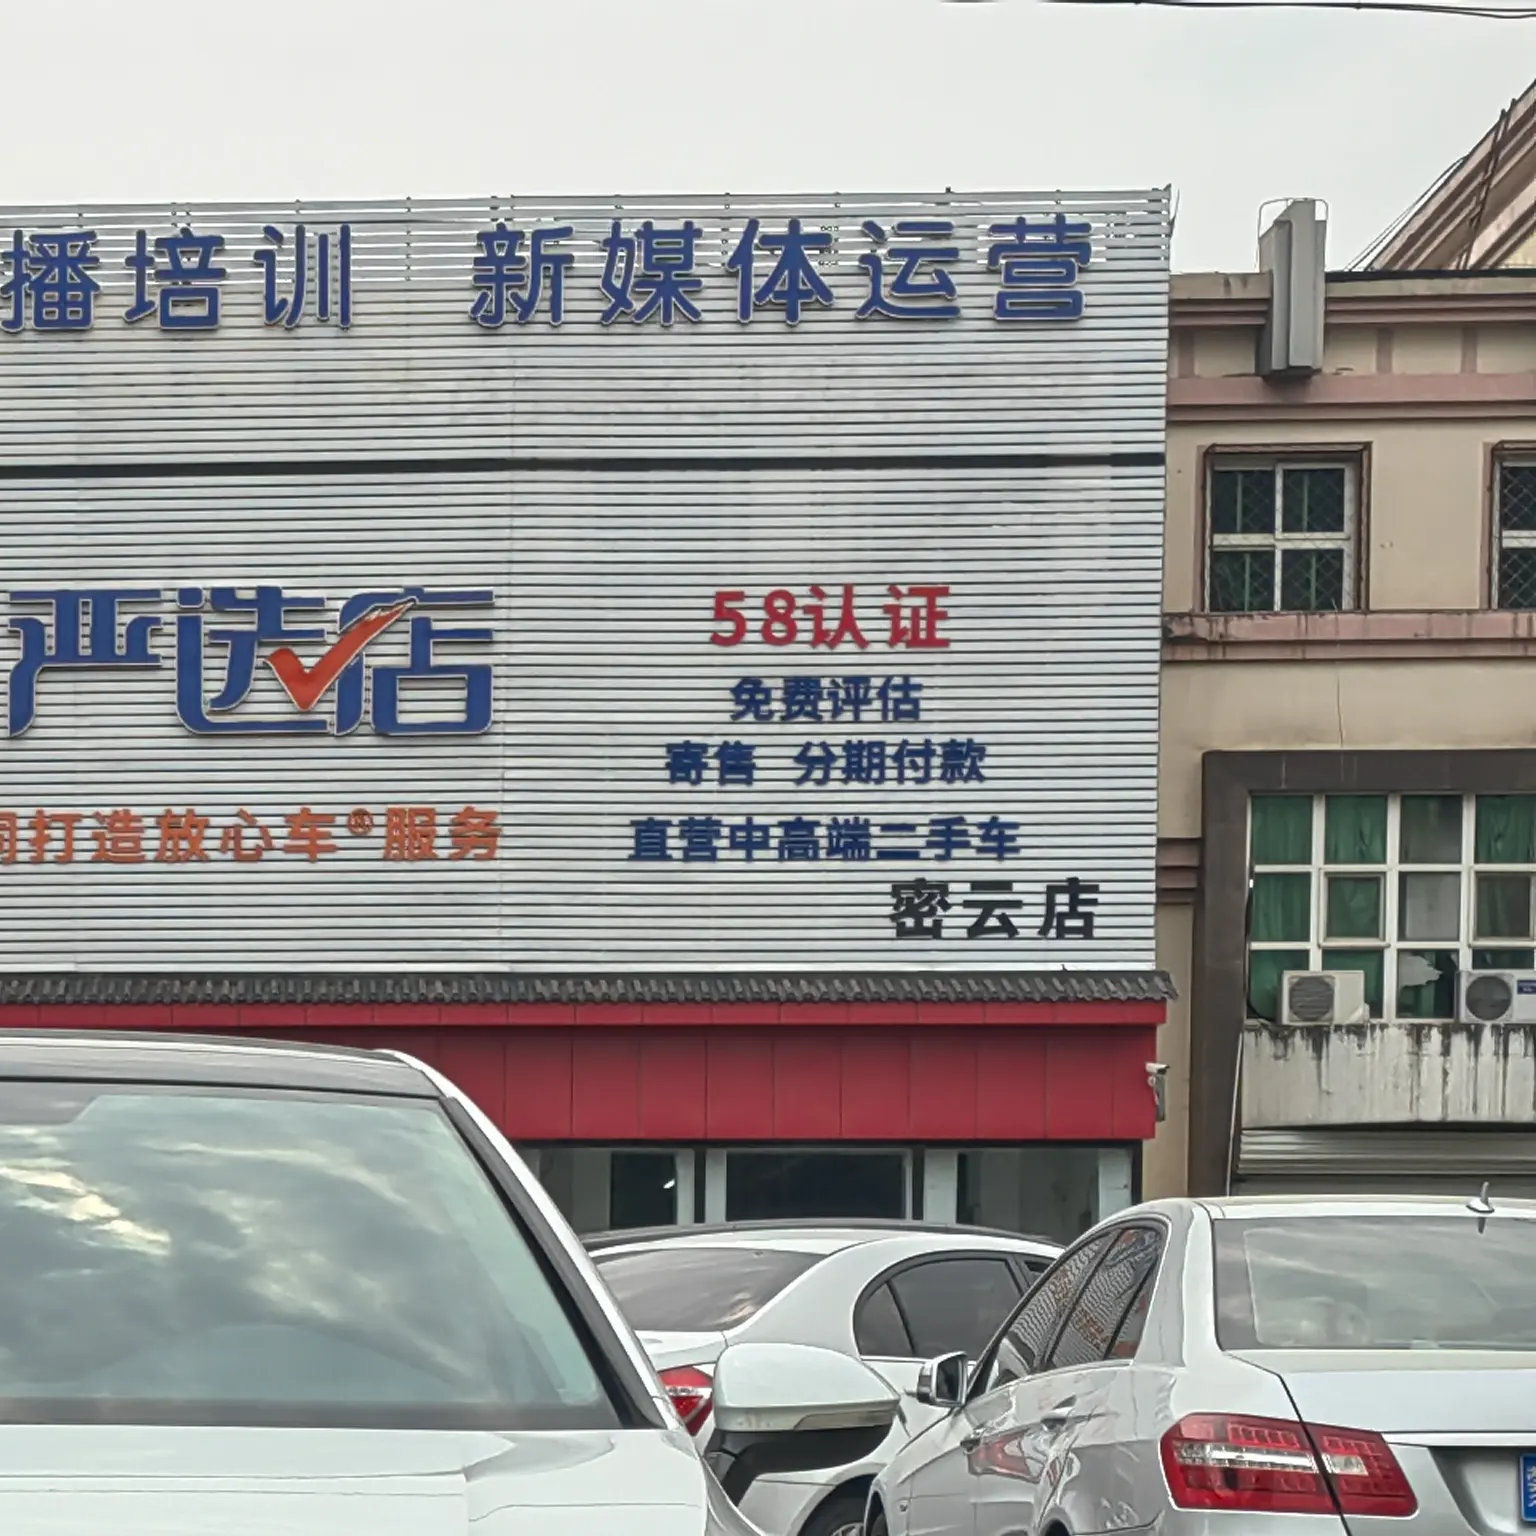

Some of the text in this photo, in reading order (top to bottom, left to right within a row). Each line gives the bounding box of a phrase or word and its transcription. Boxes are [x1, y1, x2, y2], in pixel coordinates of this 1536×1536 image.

[467, 216, 1092, 329] 新媒体运营
[710, 584, 951, 650] 58认证
[9, 585, 494, 737] 严选店
[729, 675, 923, 722] 免费评估
[665, 738, 987, 786] 寄售 分期付款
[628, 816, 1021, 863] 直营中高端二手车
[889, 877, 1100, 940] 密云店
